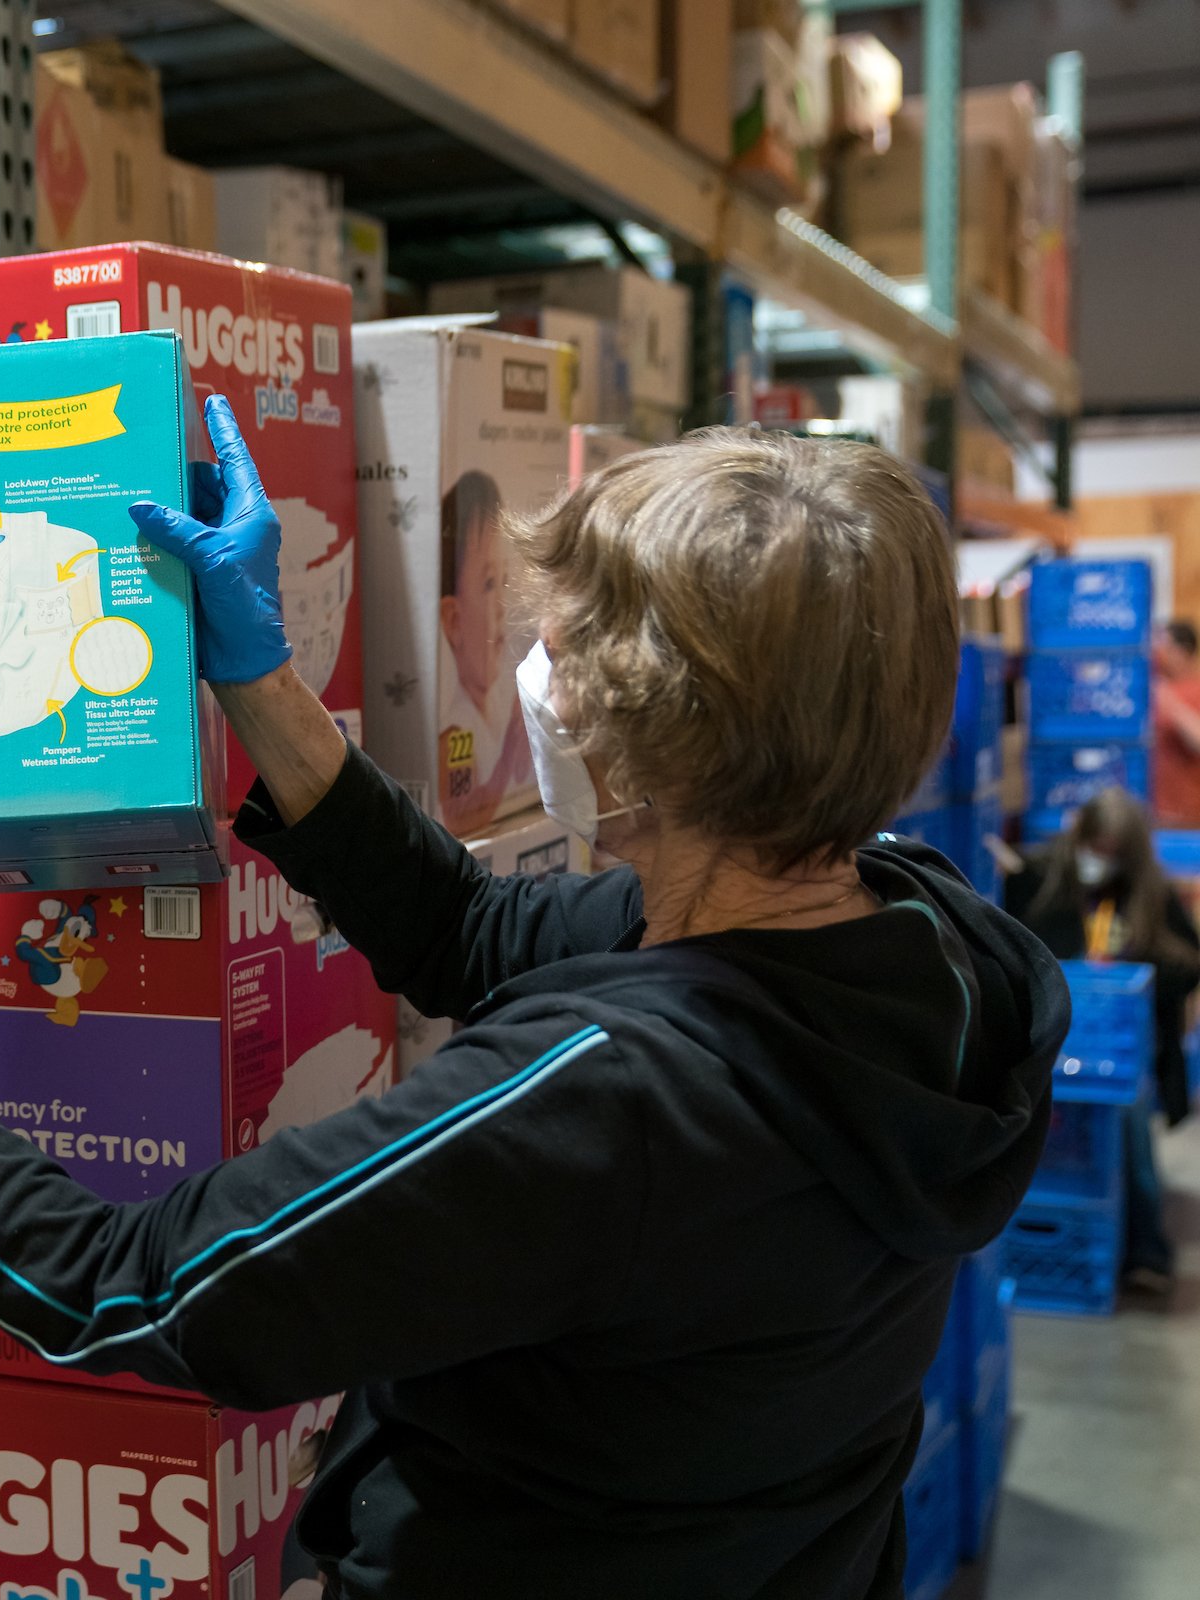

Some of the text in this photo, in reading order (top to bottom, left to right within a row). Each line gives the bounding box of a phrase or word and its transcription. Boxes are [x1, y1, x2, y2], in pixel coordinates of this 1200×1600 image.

[148, 282, 303, 380] HUGGIES
[256, 378, 298, 428] plus
[18, 401, 87, 420] protection
[26, 417, 71, 432] confort
[355, 462, 408, 480] ales
[5, 478, 49, 489] LockAway
[110, 544, 150, 554] Umbilical
[110, 554, 160, 564] Cord Notch
[111, 567, 148, 577] Encoche
[112, 577, 142, 588] pour le
[112, 587, 142, 596] cordon
[112, 596, 152, 605] ombilical
[85, 698, 158, 710] Ultra-Soft Fabric
[85, 708, 155, 719] Tissu ultra-doux
[43, 747, 81, 756] Pampers
[450, 732, 473, 763] 222
[22, 757, 58, 767] Wetness
[232, 963, 265, 984] 5-WAY FIT
[233, 980, 259, 998] SYSTEM
[50, 1100, 87, 1123] for
[12, 1128, 186, 1167] TECTION
[120, 1450, 198, 1468] DIAPERS COUCHES
